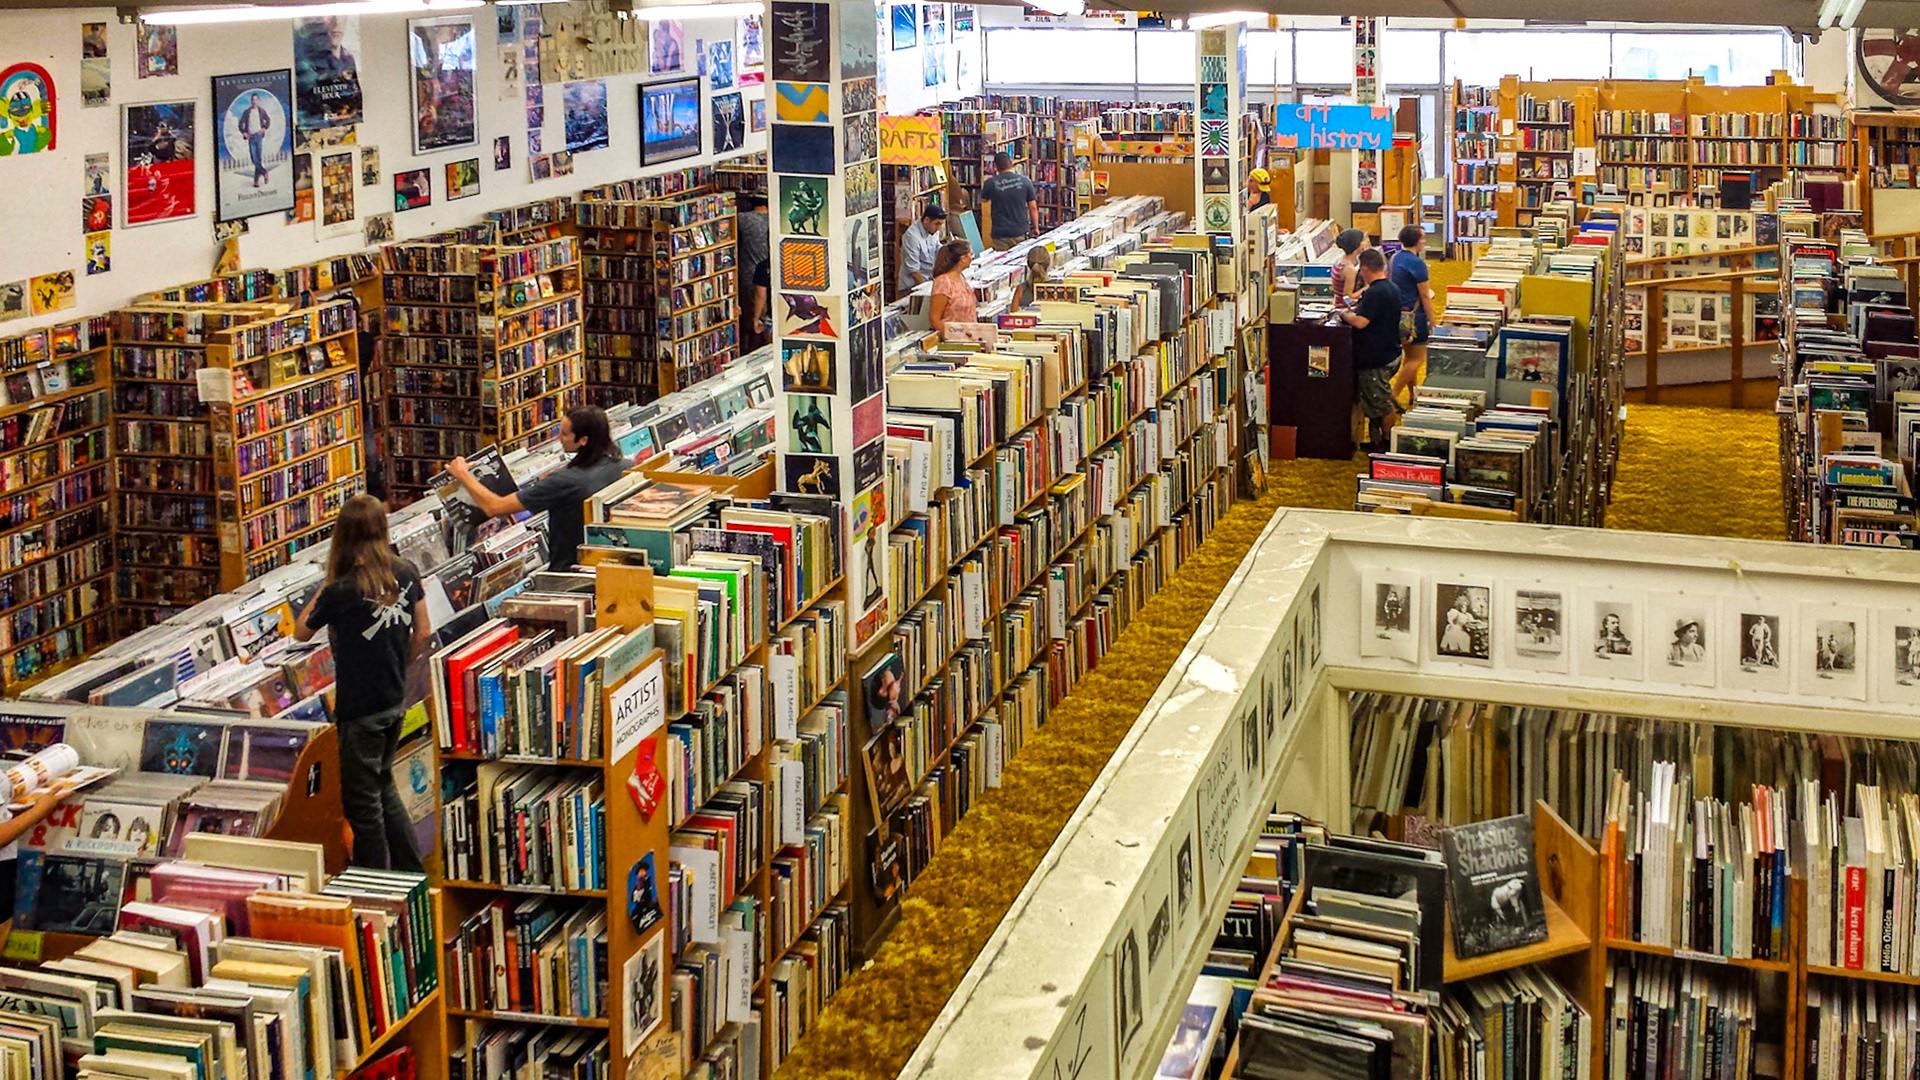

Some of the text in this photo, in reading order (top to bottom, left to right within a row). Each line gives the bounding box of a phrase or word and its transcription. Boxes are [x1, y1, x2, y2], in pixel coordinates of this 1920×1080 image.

[313, 83, 347, 95] ELEVENTH
[1295, 103, 1331, 123] art
[1311, 123, 1381, 149] history
[1379, 468, 1435, 482] SANTA FE ART
[1837, 471, 1884, 486] Lemonheads
[1847, 496, 1898, 510] THE PRETENDERS
[616, 676, 658, 726] ARTIST
[616, 705, 660, 748] MONOGRAPHS
[29, 826, 47, 848] &
[1455, 826, 1518, 853] Chasing
[1458, 847, 1528, 876] Shadows
[1219, 917, 1254, 938] TTI
[1847, 869, 1860, 963] one ken ohara
[1880, 909, 1891, 967] Hélio Oiticica
[740, 978, 749, 1007] BLAKE
